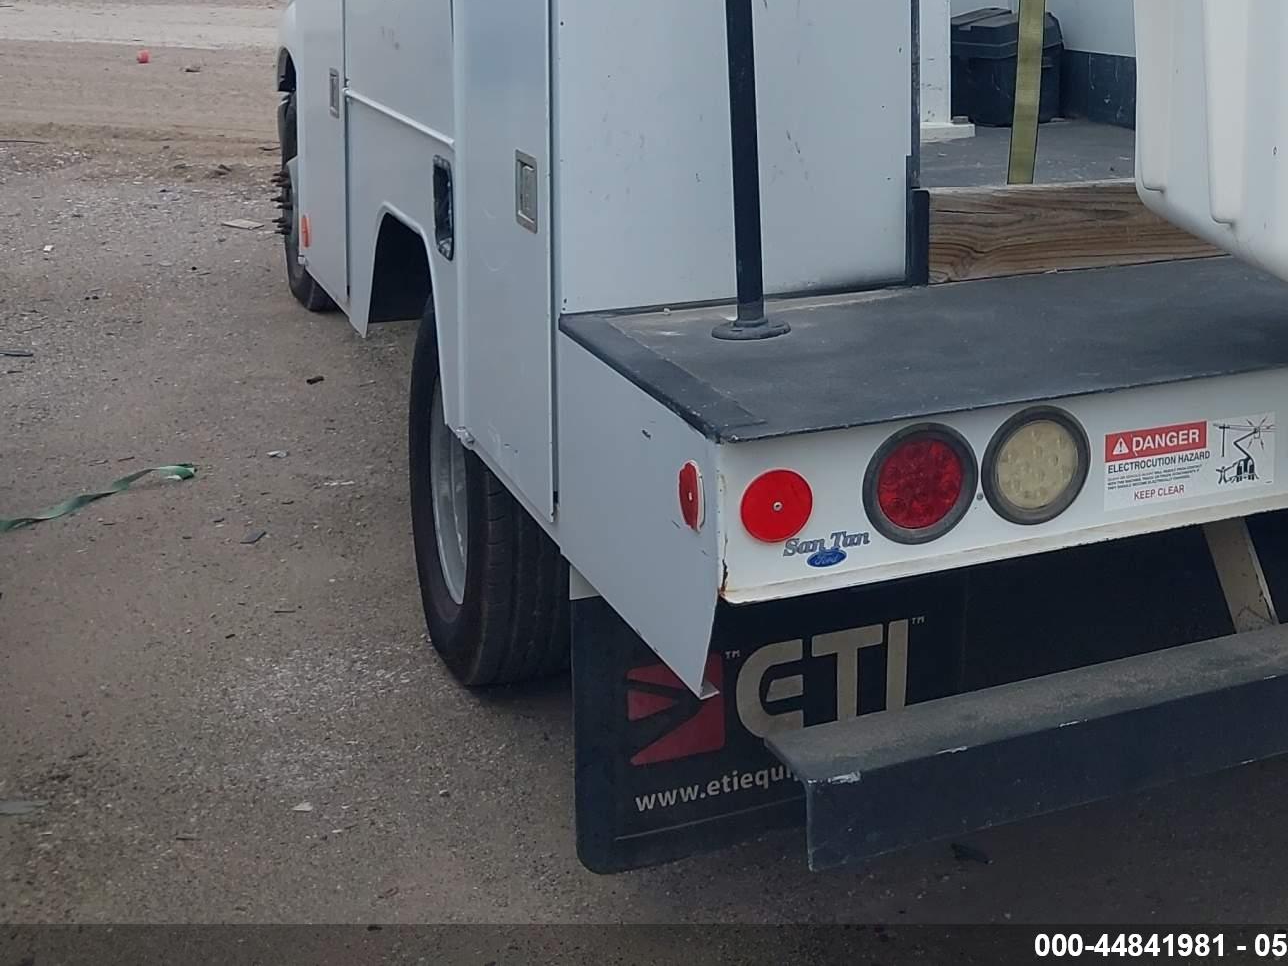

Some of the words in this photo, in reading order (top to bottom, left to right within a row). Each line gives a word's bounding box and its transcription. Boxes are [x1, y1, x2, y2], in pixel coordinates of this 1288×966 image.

[1132, 429, 1200, 452] DANGER
[1107, 455, 1177, 474] ELECTROCUTION
[1178, 450, 1211, 464] HAZARD
[1134, 489, 1156, 501] KEEP
[1157, 484, 1185, 497] CLEAR
[782, 537, 826, 557] San
[830, 531, 871, 550] Tan
[736, 618, 909, 738] ETI
[635, 764, 798, 812] www.etiequi
